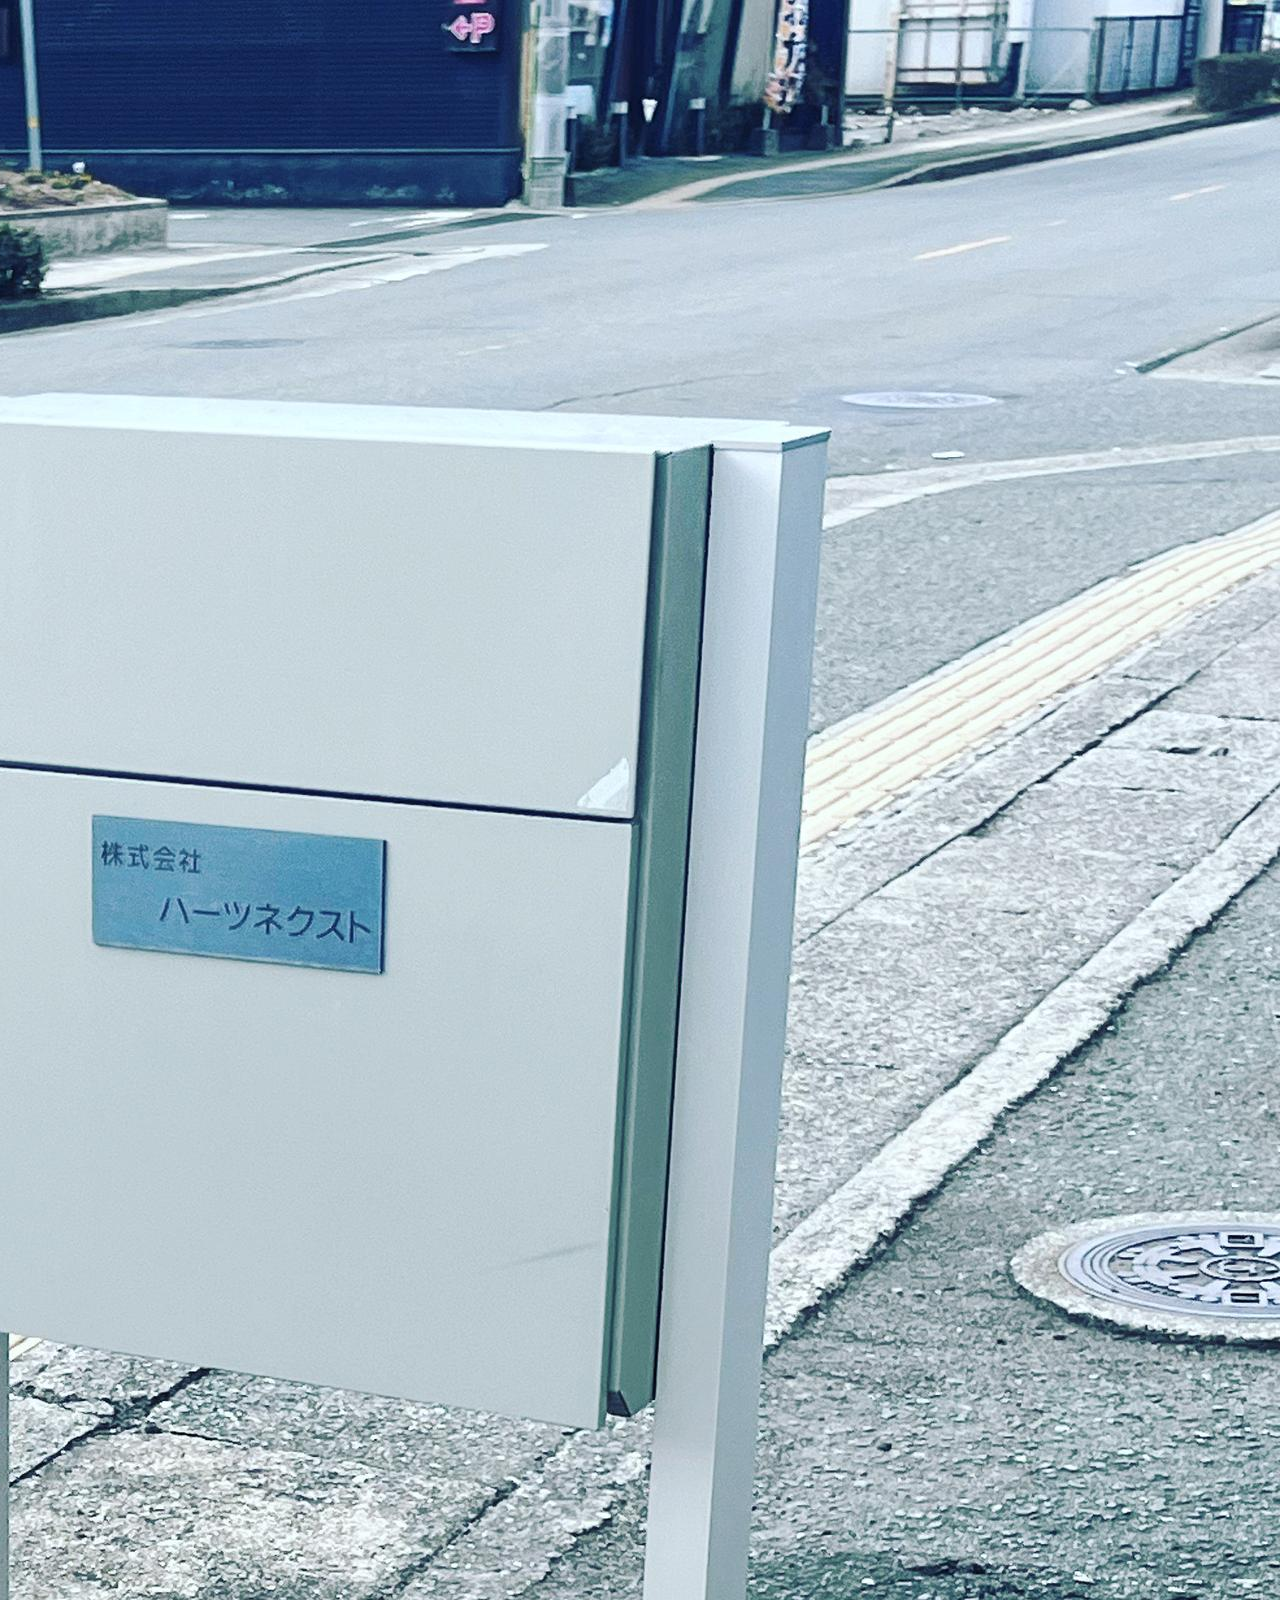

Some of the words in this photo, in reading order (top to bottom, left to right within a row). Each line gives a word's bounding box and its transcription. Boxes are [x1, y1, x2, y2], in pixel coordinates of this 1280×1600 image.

[100, 840, 202, 874] 株式会社
[159, 896, 372, 944] ハーツネクスト
